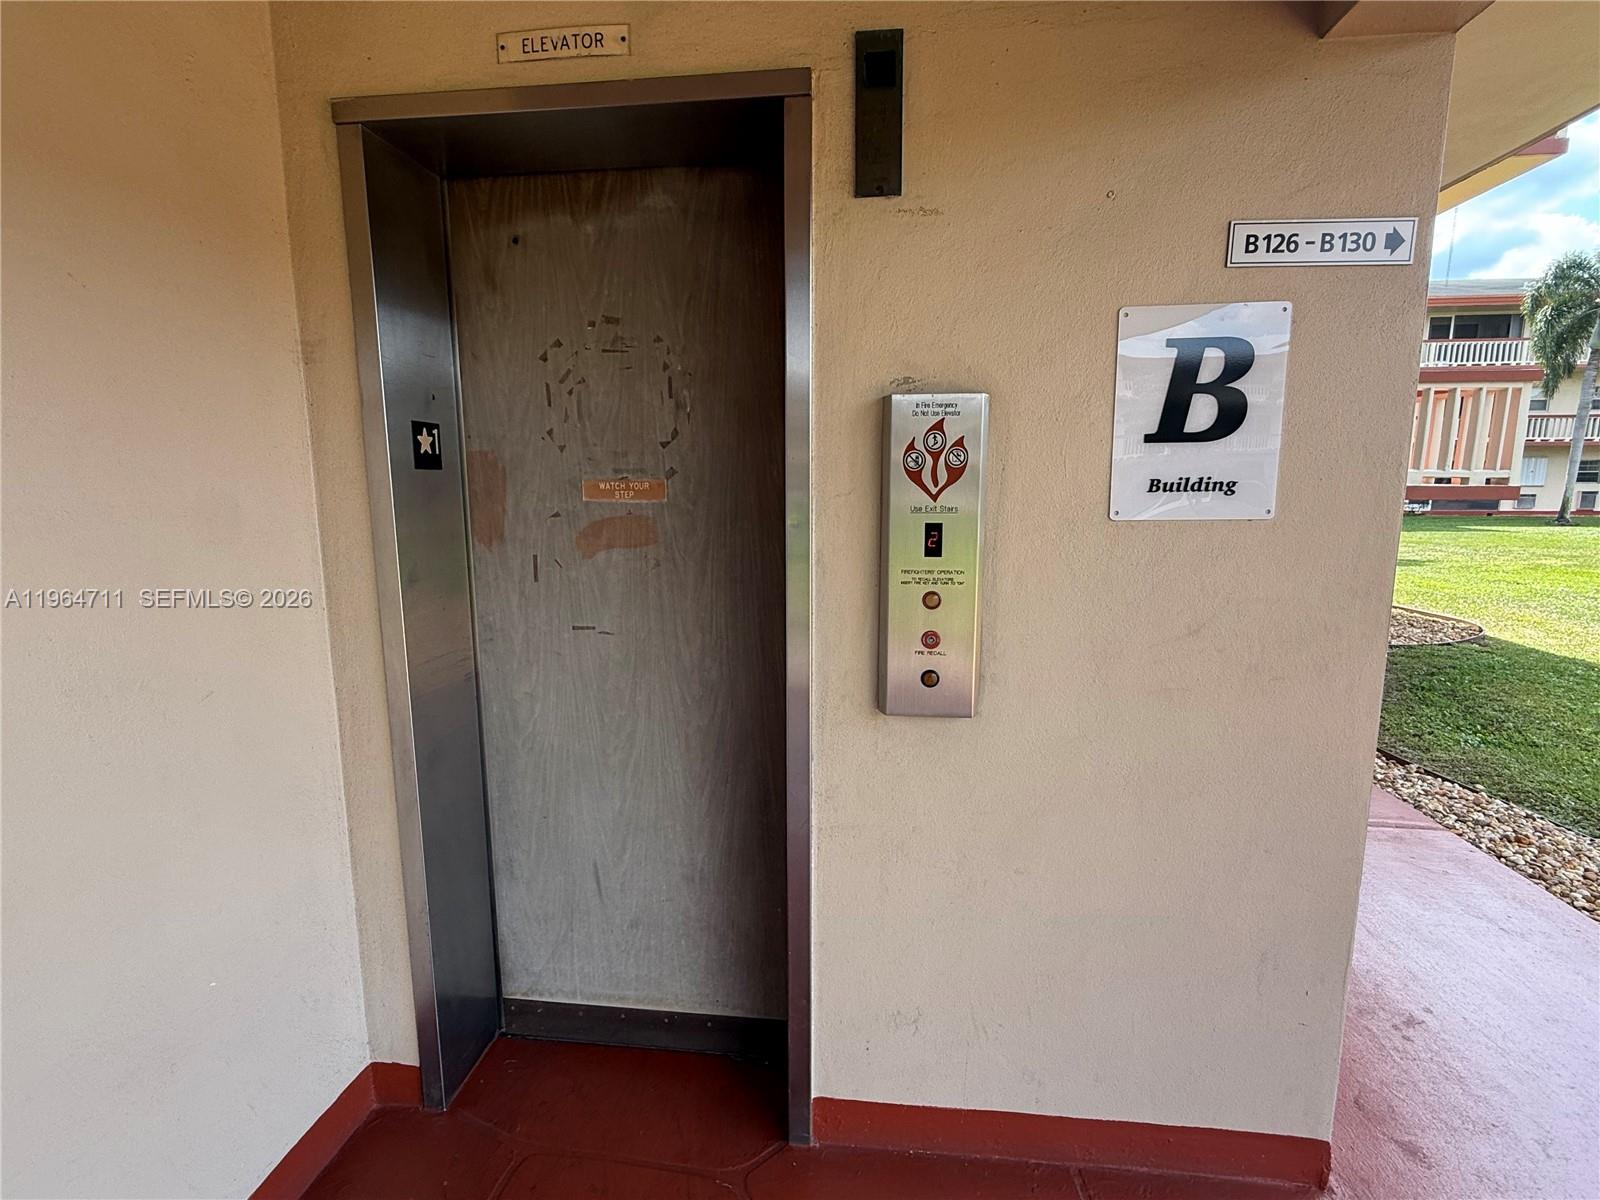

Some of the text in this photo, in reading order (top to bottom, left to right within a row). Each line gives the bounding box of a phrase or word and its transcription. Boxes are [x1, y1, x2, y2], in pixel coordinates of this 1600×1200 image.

[521, 32, 604, 54] ELEVATOR
[1144, 336, 1256, 444] B
[932, 402, 958, 410] Emergency
[432, 428, 439, 455] 1
[598, 481, 650, 491] WATCH YOUR
[614, 490, 634, 499] STEP
[1146, 476, 1239, 496] Building
[927, 531, 939, 548] 2
